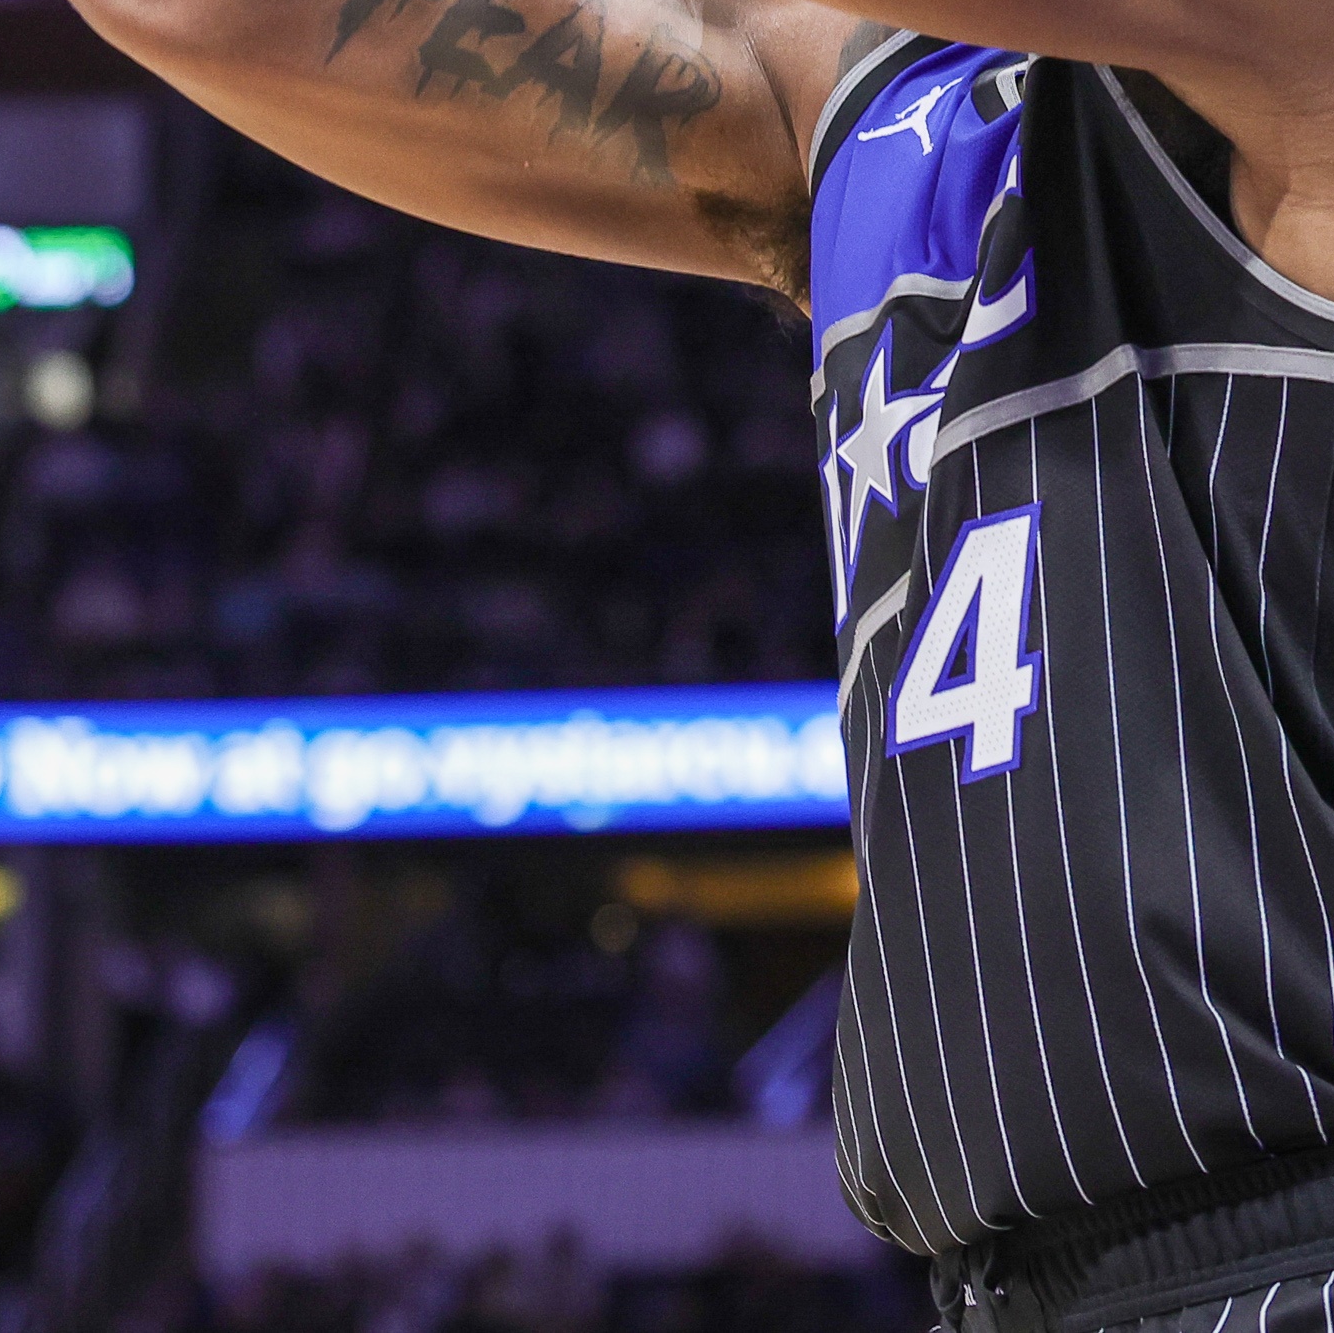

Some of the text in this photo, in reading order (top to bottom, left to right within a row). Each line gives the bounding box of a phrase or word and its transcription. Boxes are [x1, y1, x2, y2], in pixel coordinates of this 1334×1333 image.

[885, 500, 1043, 785] 4
[3, 716, 209, 818] Now
[213, 715, 305, 815] at
